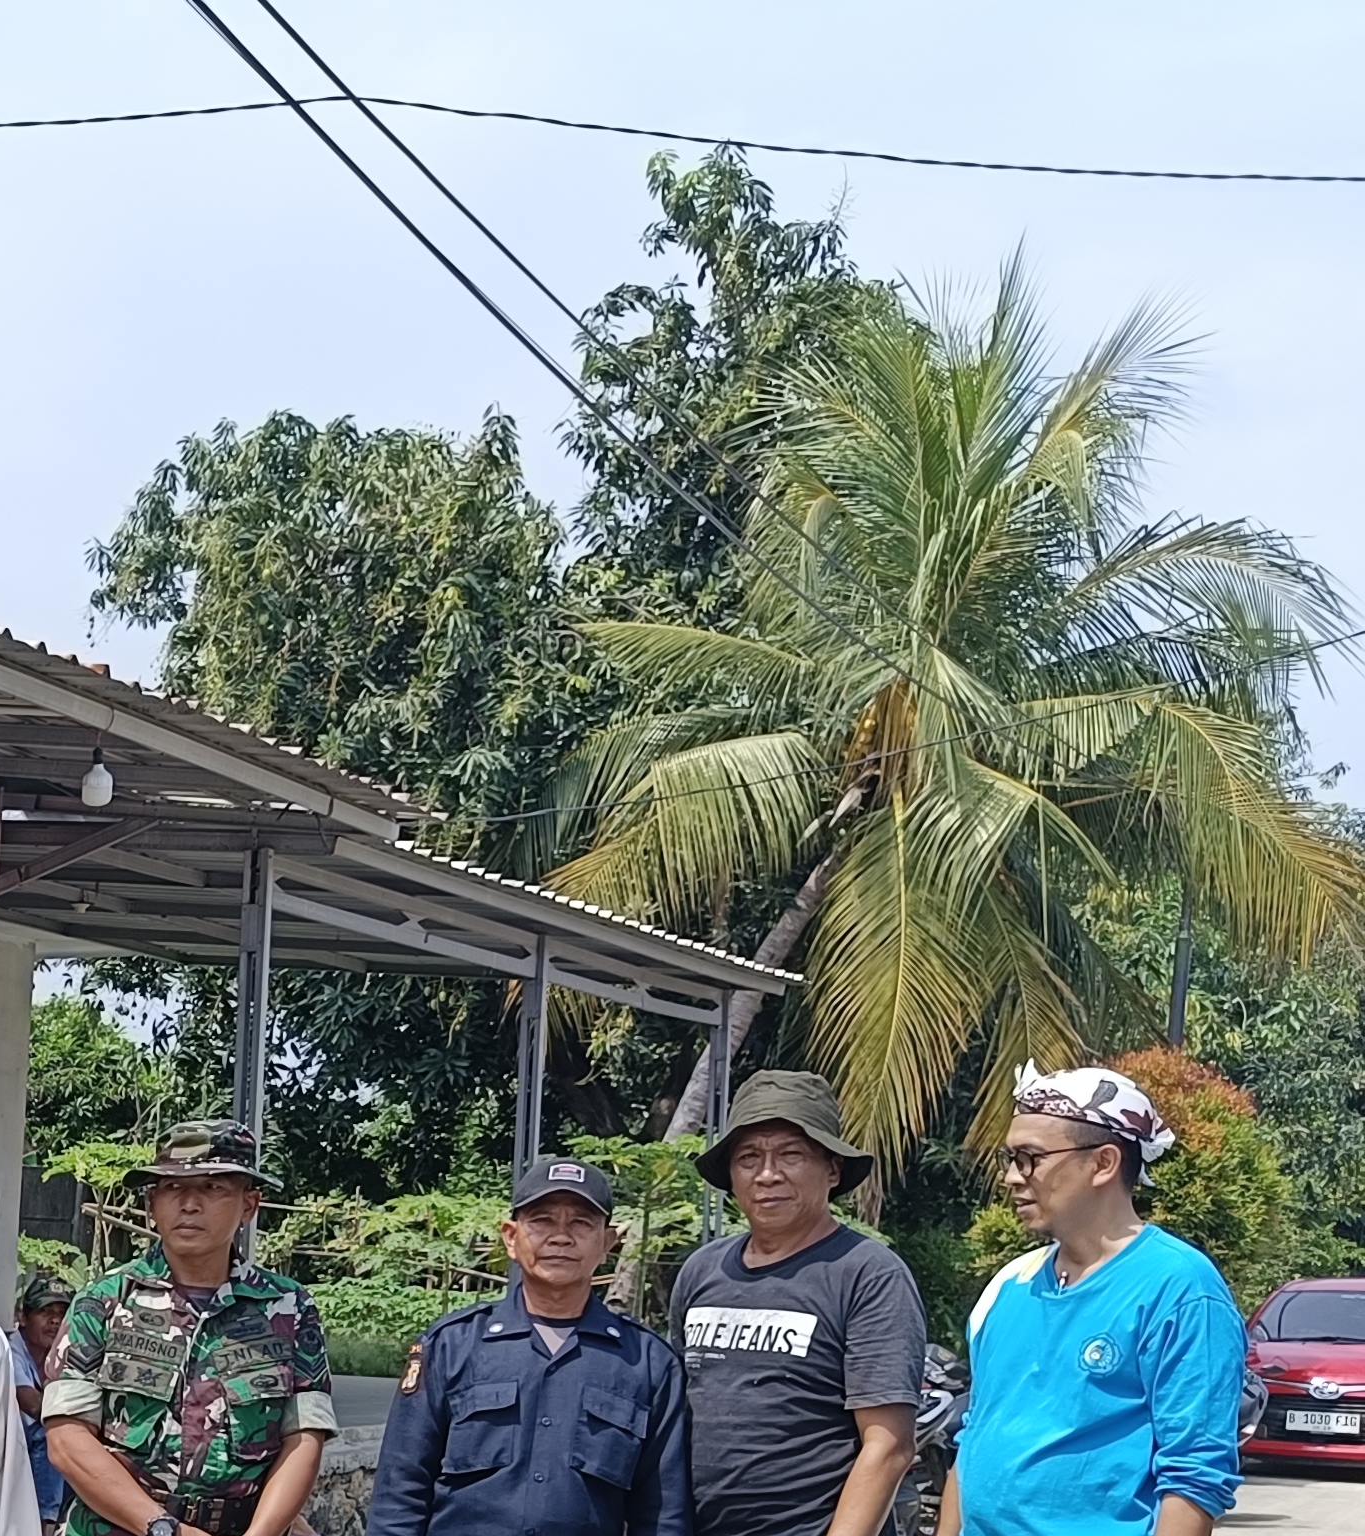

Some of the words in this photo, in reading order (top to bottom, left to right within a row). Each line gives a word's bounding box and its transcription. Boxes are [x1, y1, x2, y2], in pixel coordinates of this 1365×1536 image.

[722, 1324, 798, 1353] JEANS
[1288, 1412, 1296, 1424] B
[1303, 1413, 1331, 1426] 1030
